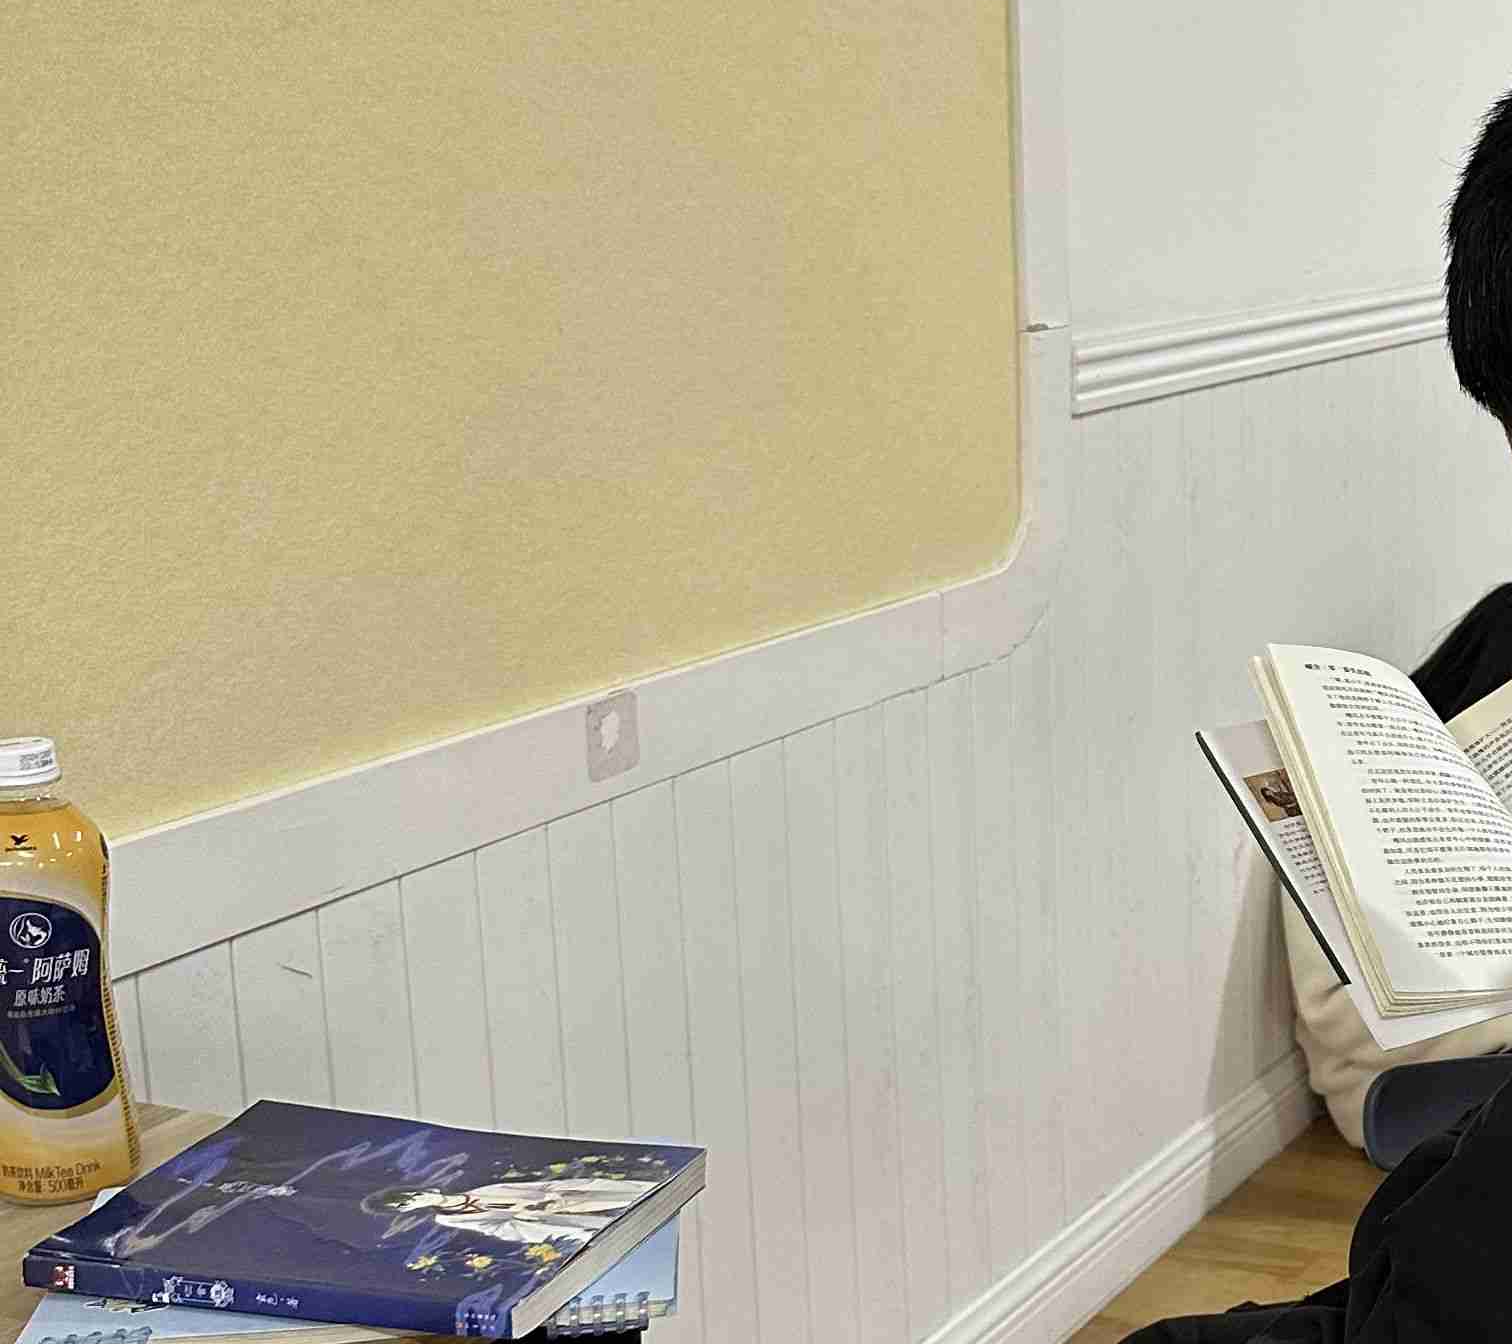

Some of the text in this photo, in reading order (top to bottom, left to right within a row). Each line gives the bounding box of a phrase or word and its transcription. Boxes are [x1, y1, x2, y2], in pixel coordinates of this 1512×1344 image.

[31, 948, 90, 984] 阿萨姆
[14, 985, 66, 1006] 原味奶茶
